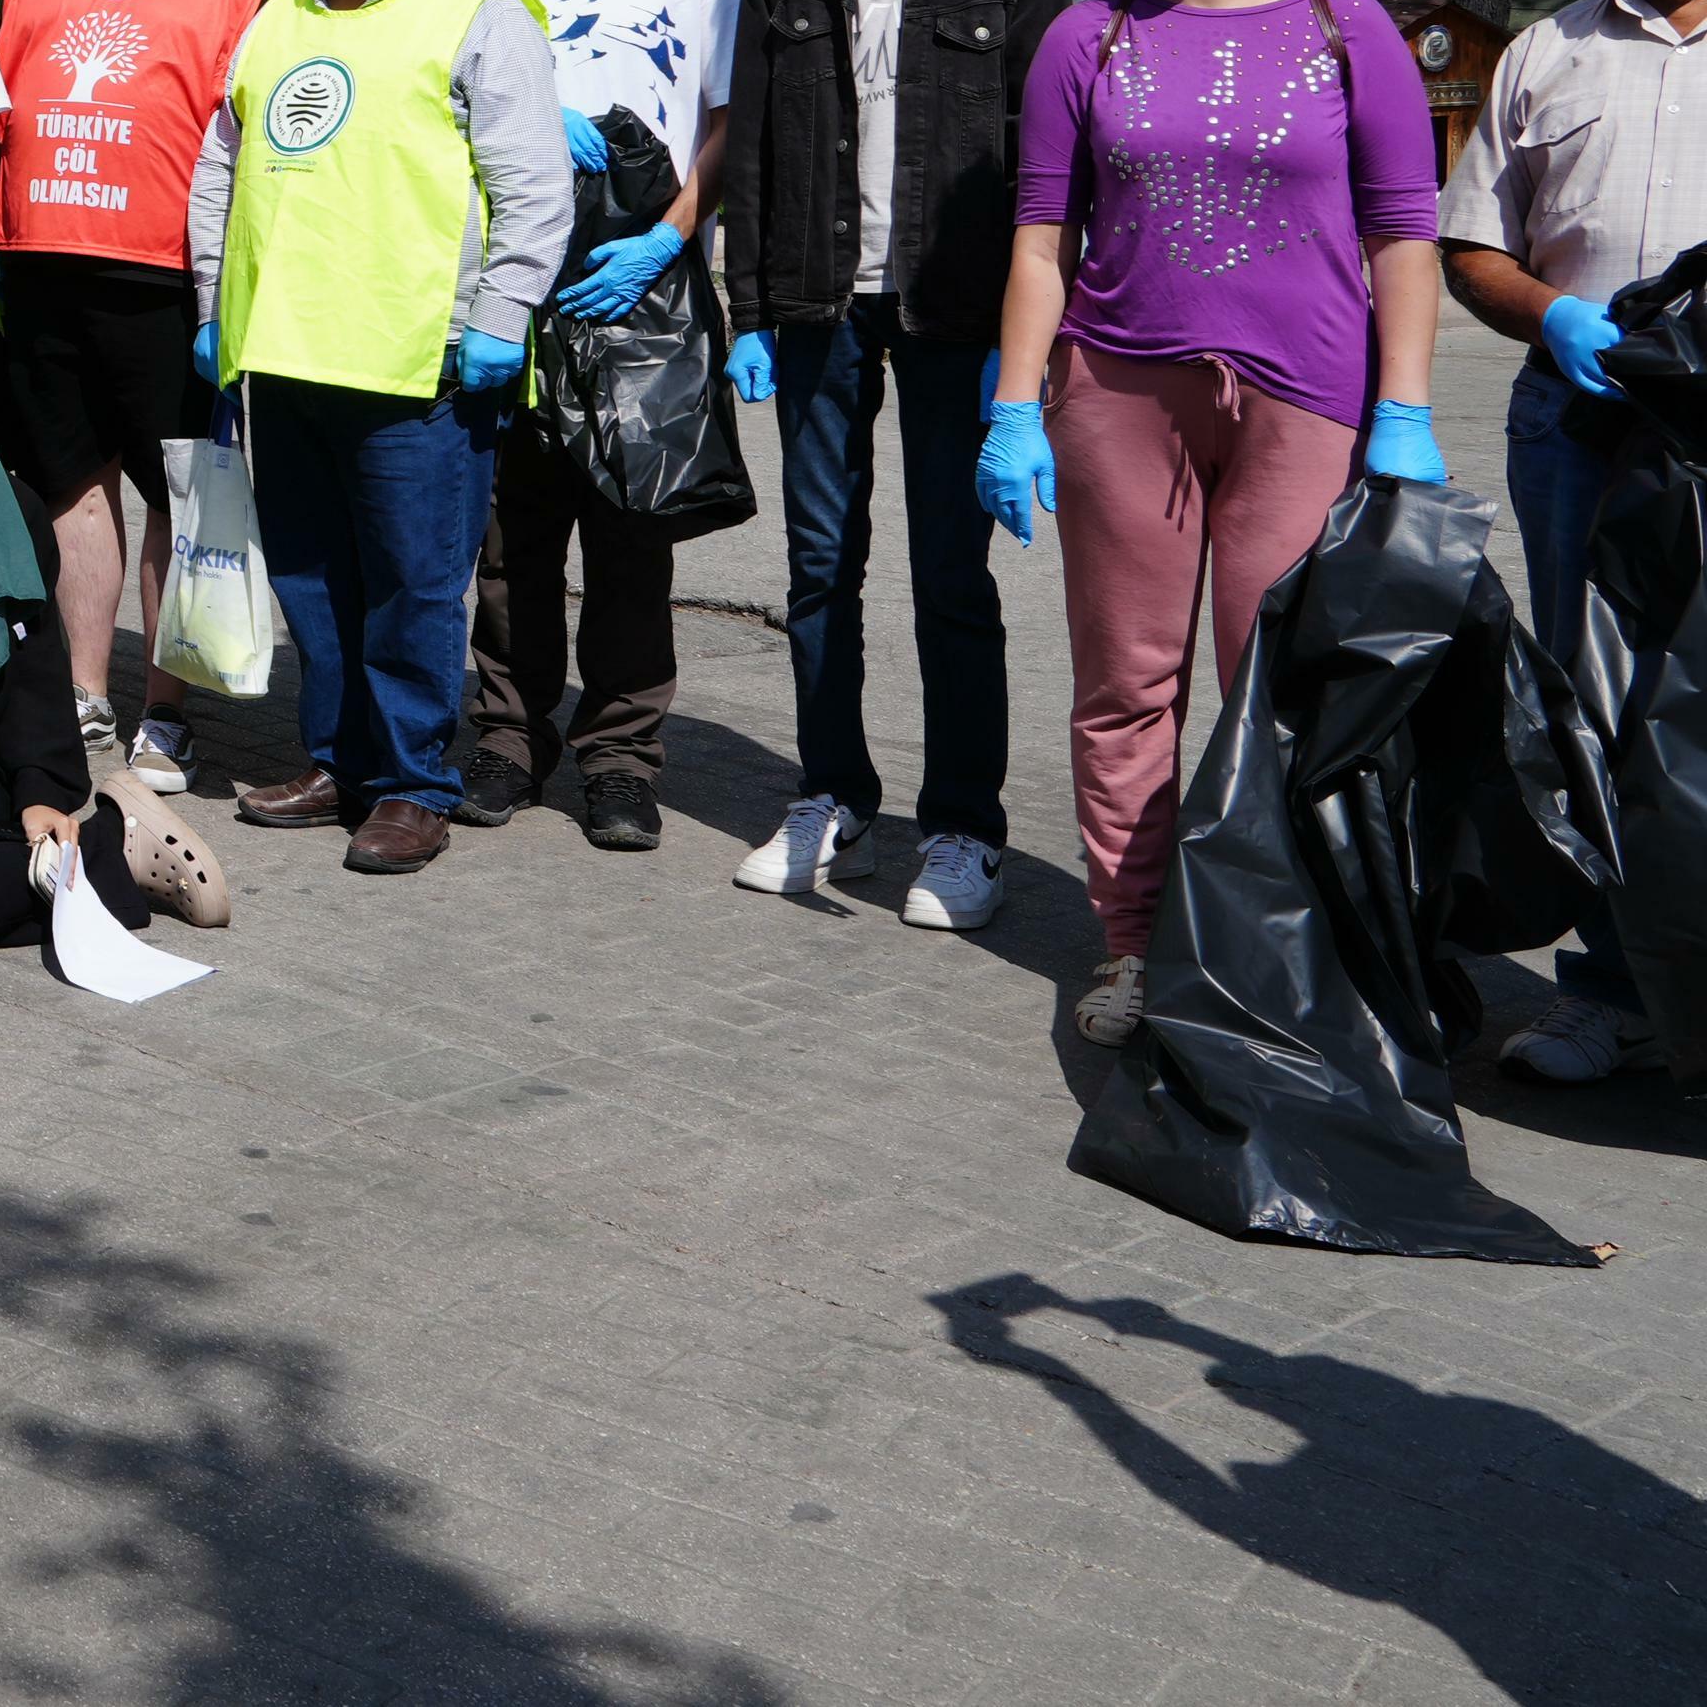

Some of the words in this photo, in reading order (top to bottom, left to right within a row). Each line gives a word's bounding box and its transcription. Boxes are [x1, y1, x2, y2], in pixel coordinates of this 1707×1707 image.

[35, 107, 134, 145] TÜRKİYE
[53, 143, 98, 175] ÇÖL
[29, 179, 129, 212] OLMASIN
